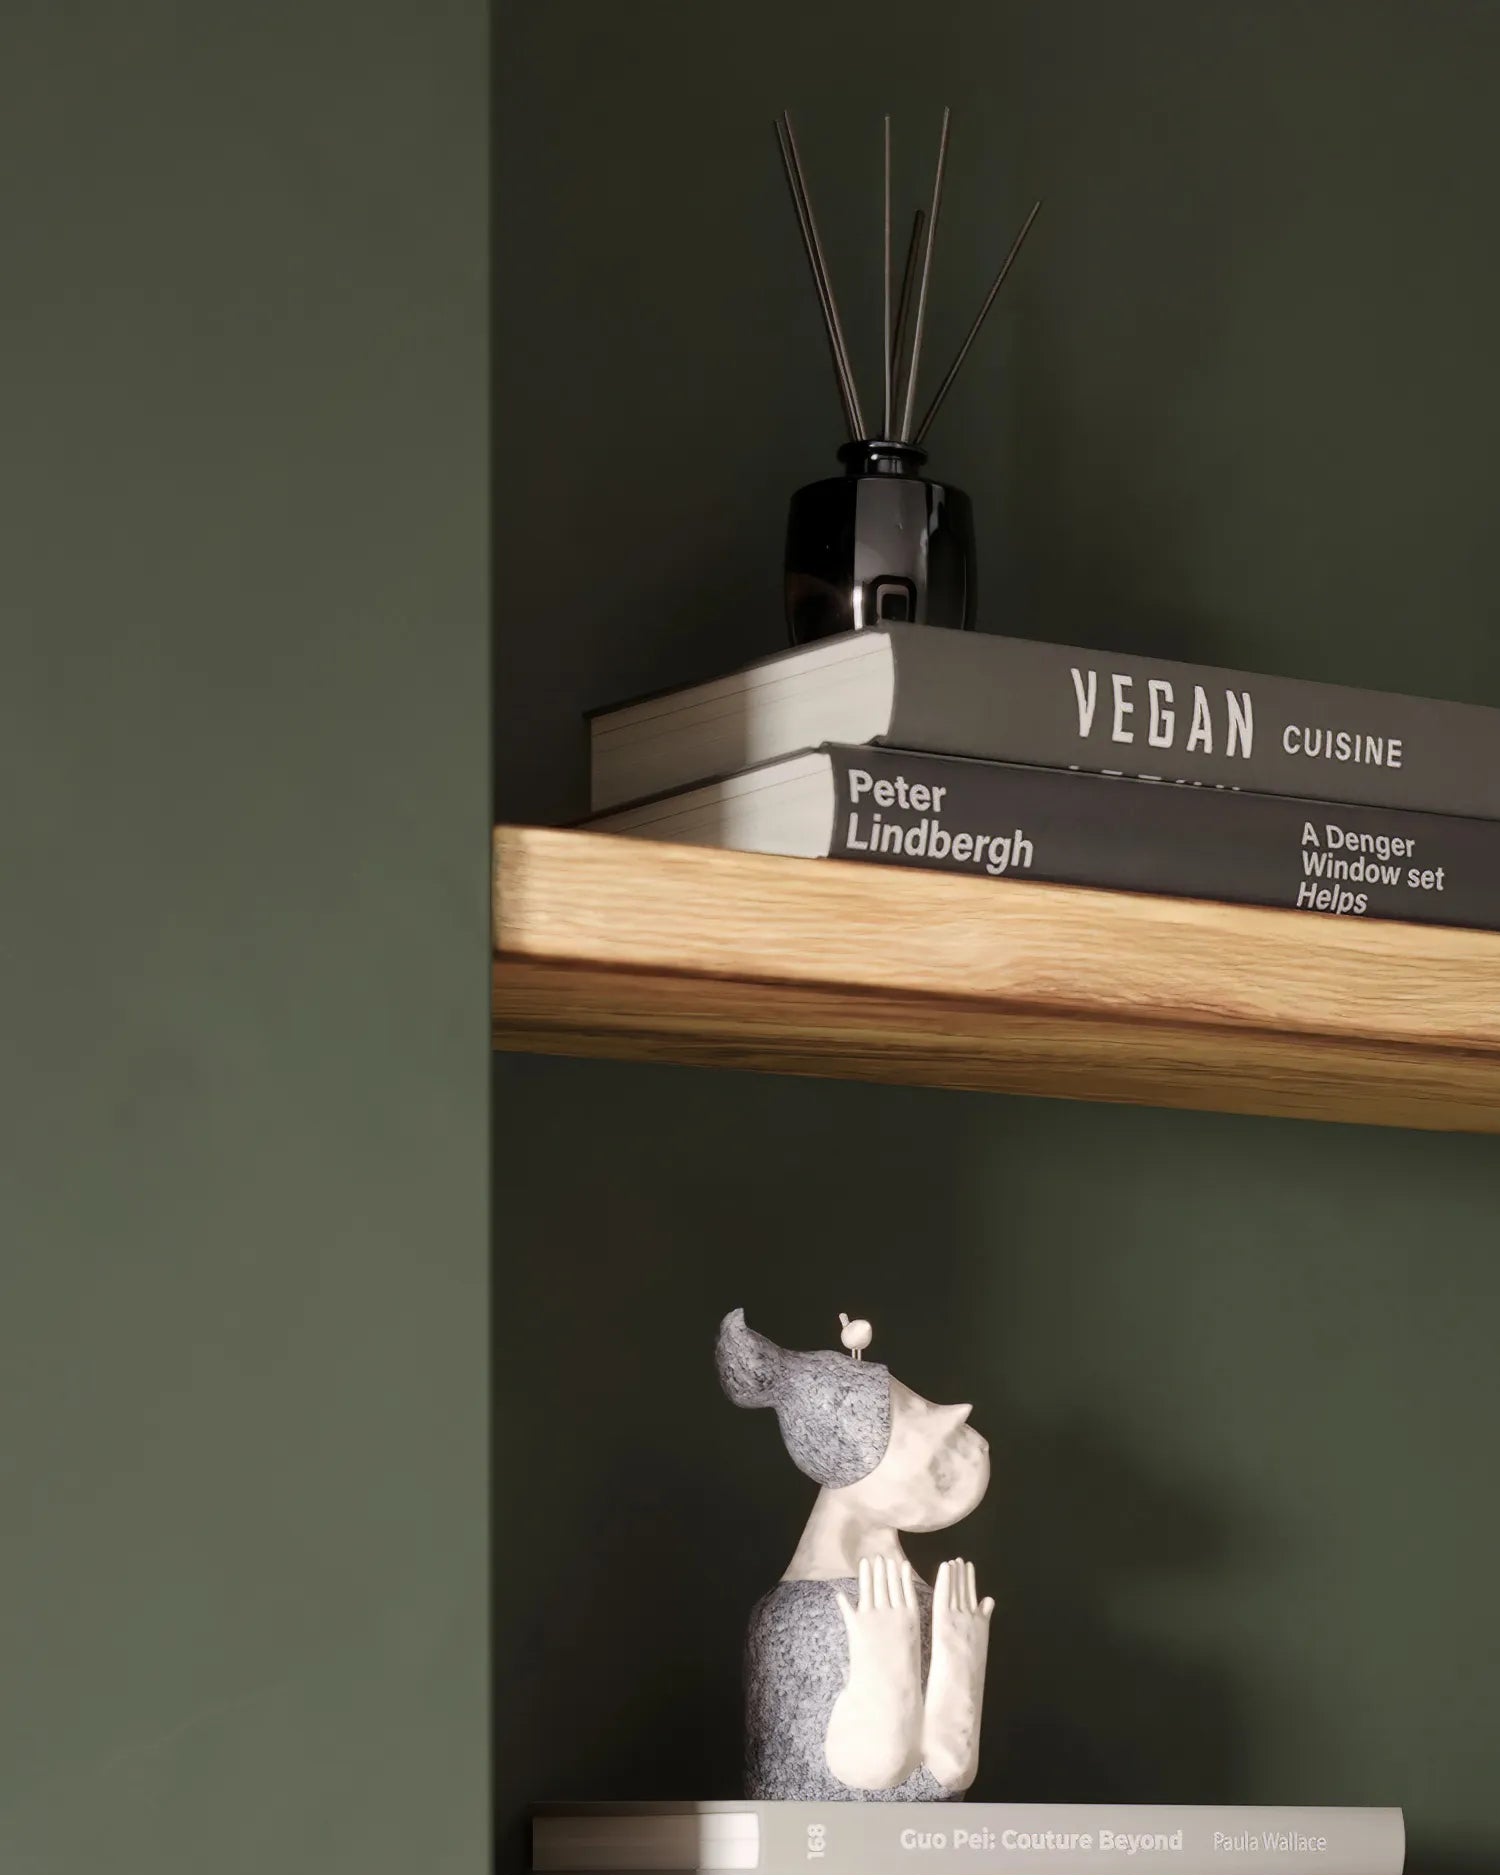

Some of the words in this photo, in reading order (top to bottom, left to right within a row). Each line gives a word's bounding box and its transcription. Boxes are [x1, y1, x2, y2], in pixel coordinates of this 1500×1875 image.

[1070, 667, 1254, 760] VEGAN
[1282, 725, 1403, 768] CUISINE
[848, 769, 947, 813] Peter
[847, 812, 1034, 875] Lindbergh
[1302, 821, 1321, 849] A
[1326, 824, 1415, 859] Denger
[1302, 851, 1401, 885] Window
[1407, 866, 1445, 892] set
[1297, 881, 1368, 915] Helps
[807, 1823, 826, 1860] 168
[901, 1828, 946, 1850] Guo
[952, 1828, 996, 1850] Pei:
[1002, 1830, 1093, 1851] Couture
[1099, 1829, 1184, 1855] Beyond
[1213, 1831, 1259, 1852] Paula
[1262, 1831, 1327, 1852] Wallace
